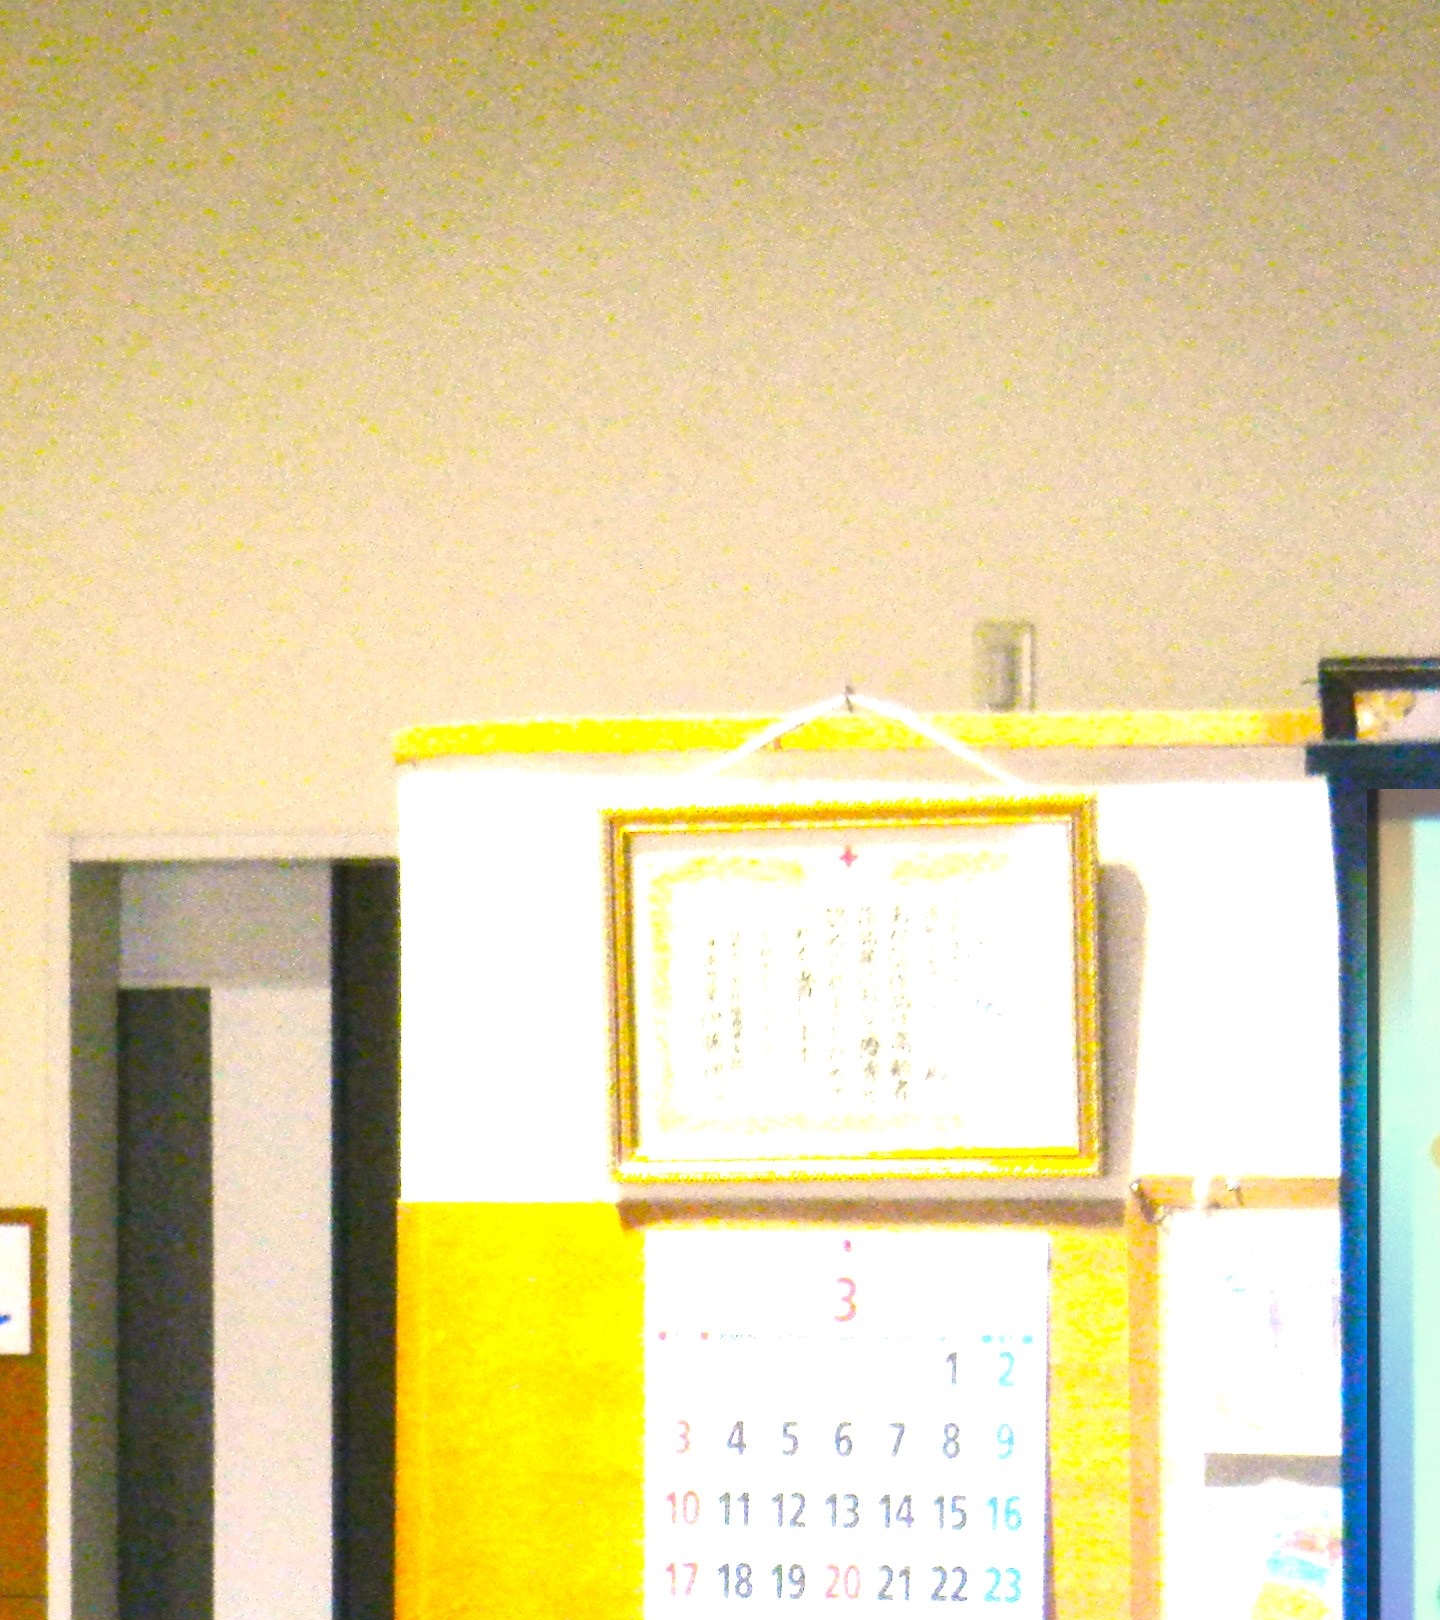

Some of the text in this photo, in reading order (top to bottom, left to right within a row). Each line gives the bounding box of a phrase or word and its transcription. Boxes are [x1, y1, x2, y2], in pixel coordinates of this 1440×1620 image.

[834, 1275, 861, 1324] 3
[944, 1350, 1018, 1390] 1 2
[674, 1419, 1018, 1463] 3 4 5 6 7 8 9
[666, 1489, 1025, 1534] 10 11 12 13 14 15 16
[665, 1561, 1024, 1606] 17 18 19 20 21 22 23
